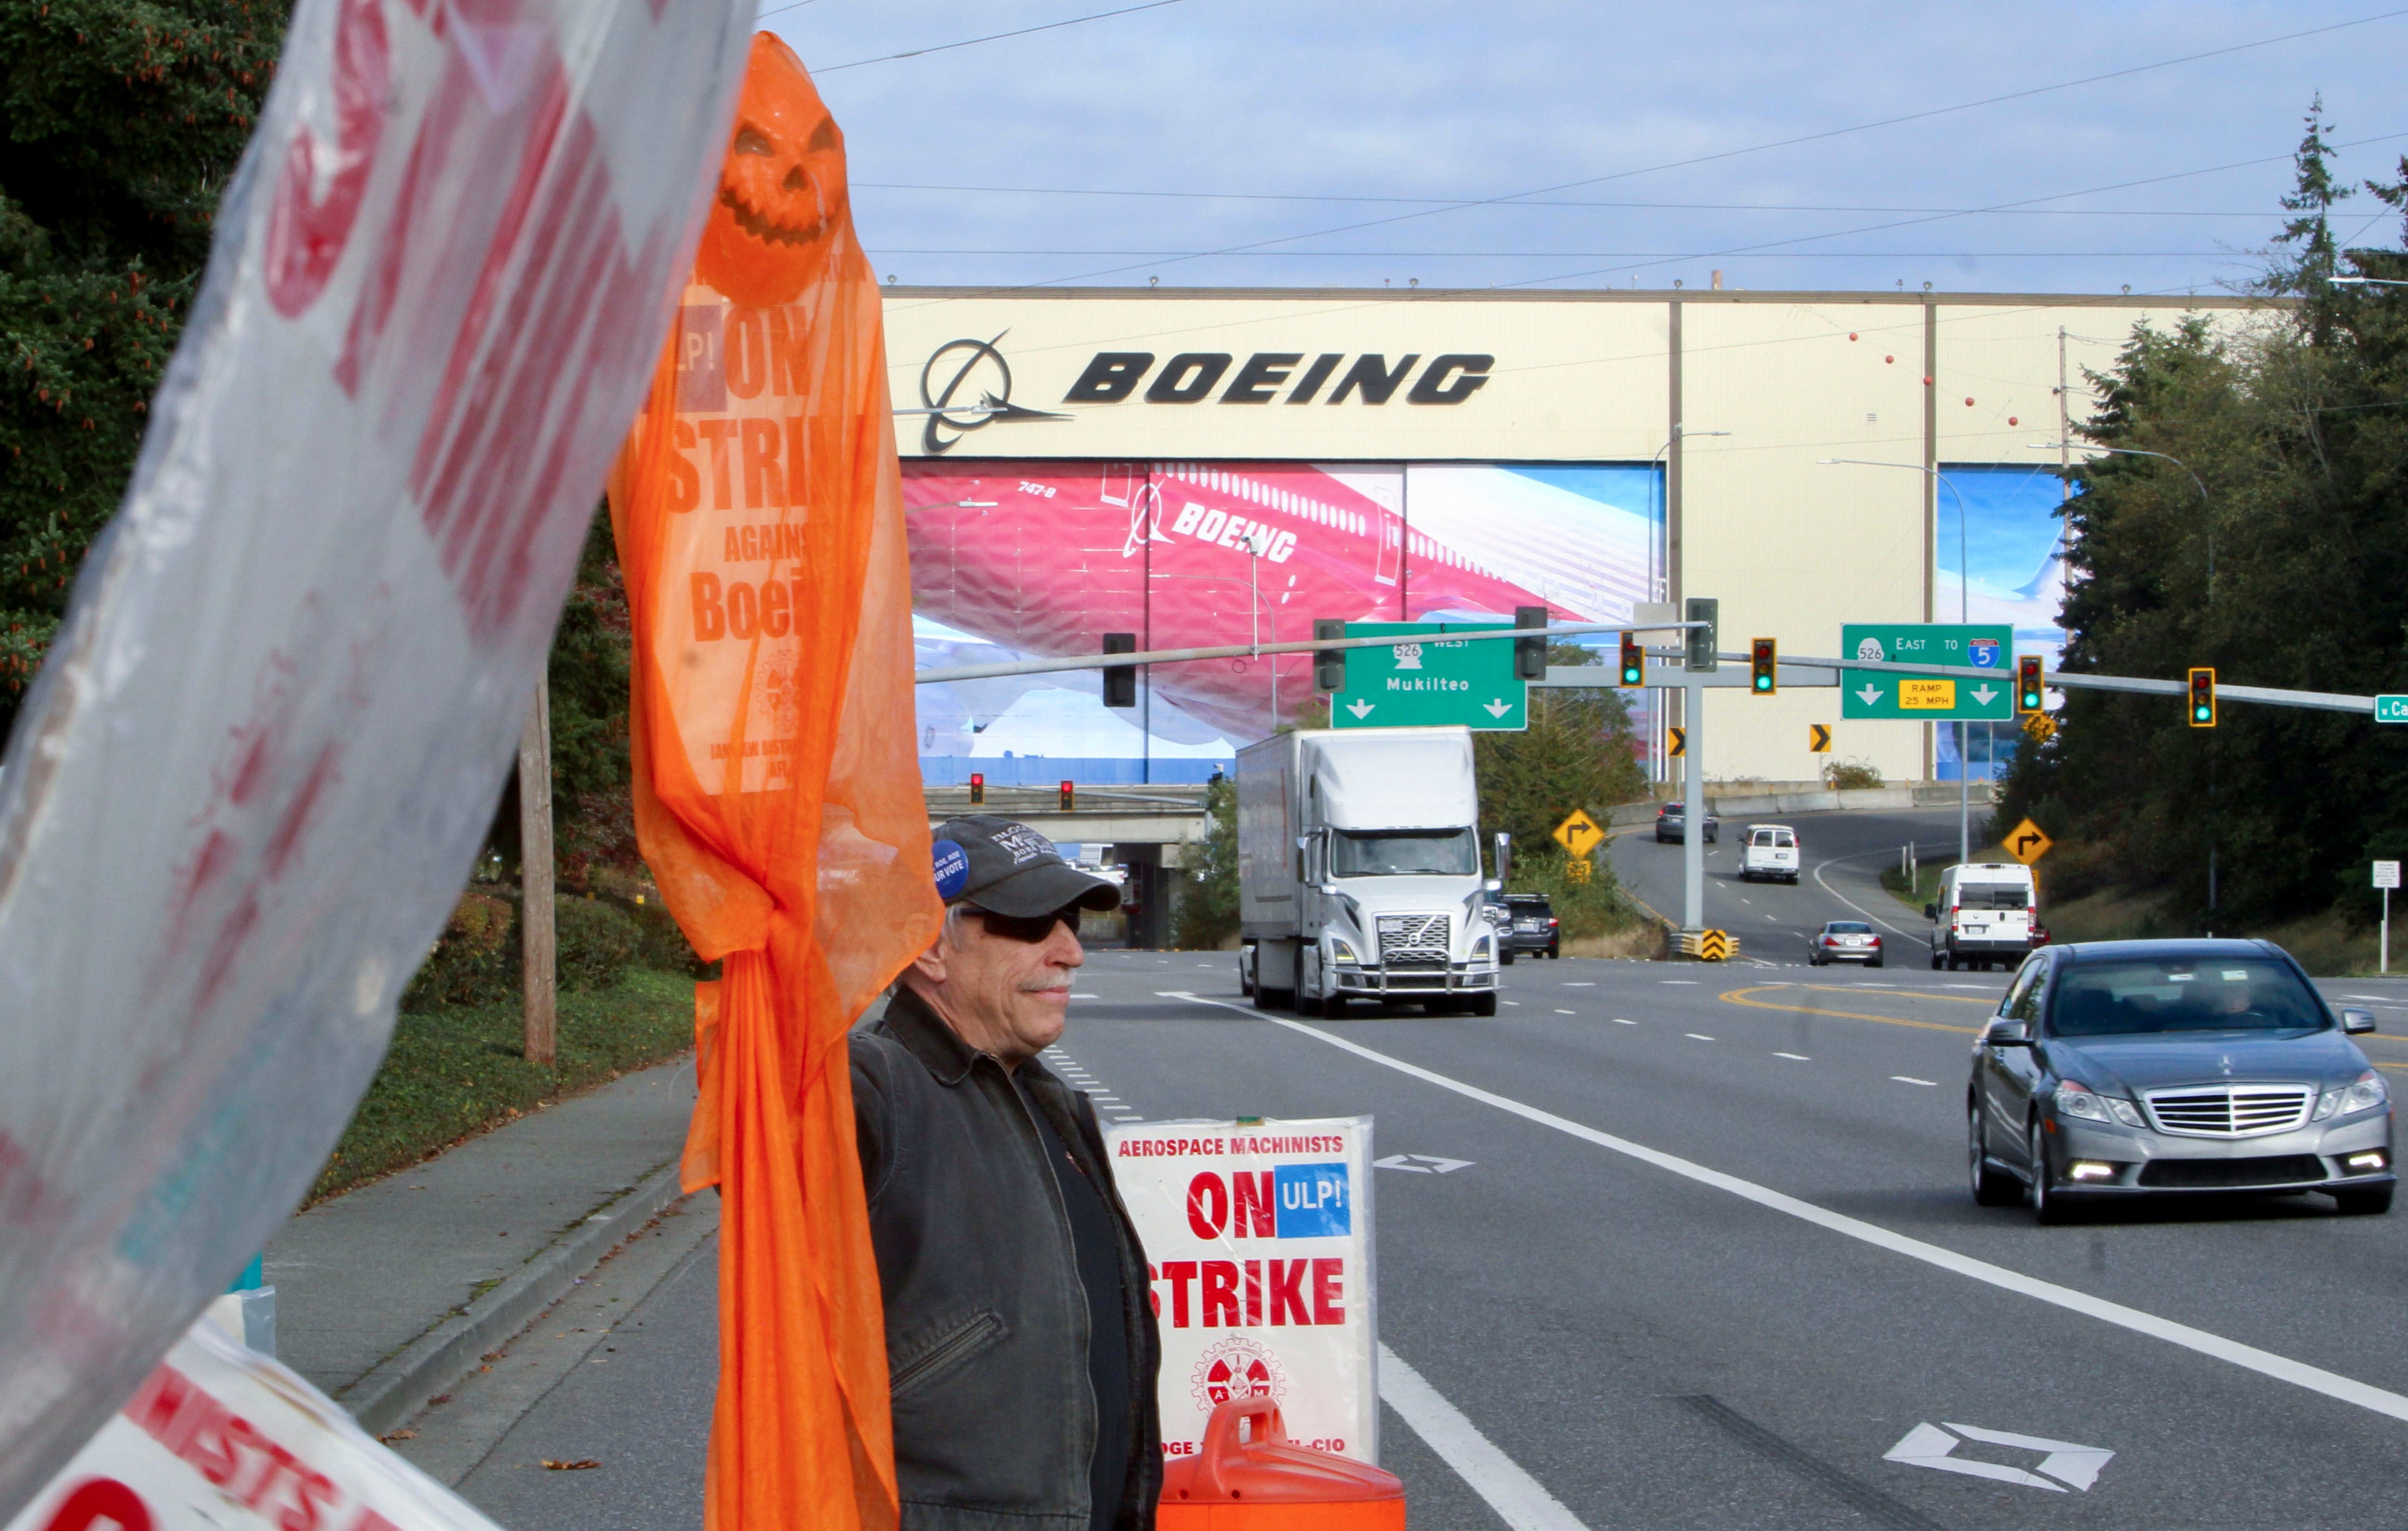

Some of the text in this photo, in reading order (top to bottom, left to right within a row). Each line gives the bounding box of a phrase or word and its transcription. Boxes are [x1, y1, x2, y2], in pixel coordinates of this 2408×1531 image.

[1062, 352, 1496, 405] BOEING
[1017, 480, 1057, 498] 747-8
[1171, 501, 1297, 564] BOEING
[1396, 644, 1419, 657] 526
[1859, 648, 1882, 660] 526
[1895, 638, 1926, 651] EAST
[1944, 639, 1958, 651] TO
[1978, 647, 1991, 665] 5
[1387, 677, 1469, 691] Mukilteo
[1911, 684, 1942, 692] RAMP
[1905, 697, 1949, 705] 25 MPH
[944, 860, 964, 877] VOTE
[1119, 1136, 1344, 1157] AEROSPACE MACHINISTS
[1282, 1180, 1343, 1210] ULP!
[1187, 1171, 1276, 1240] ON
